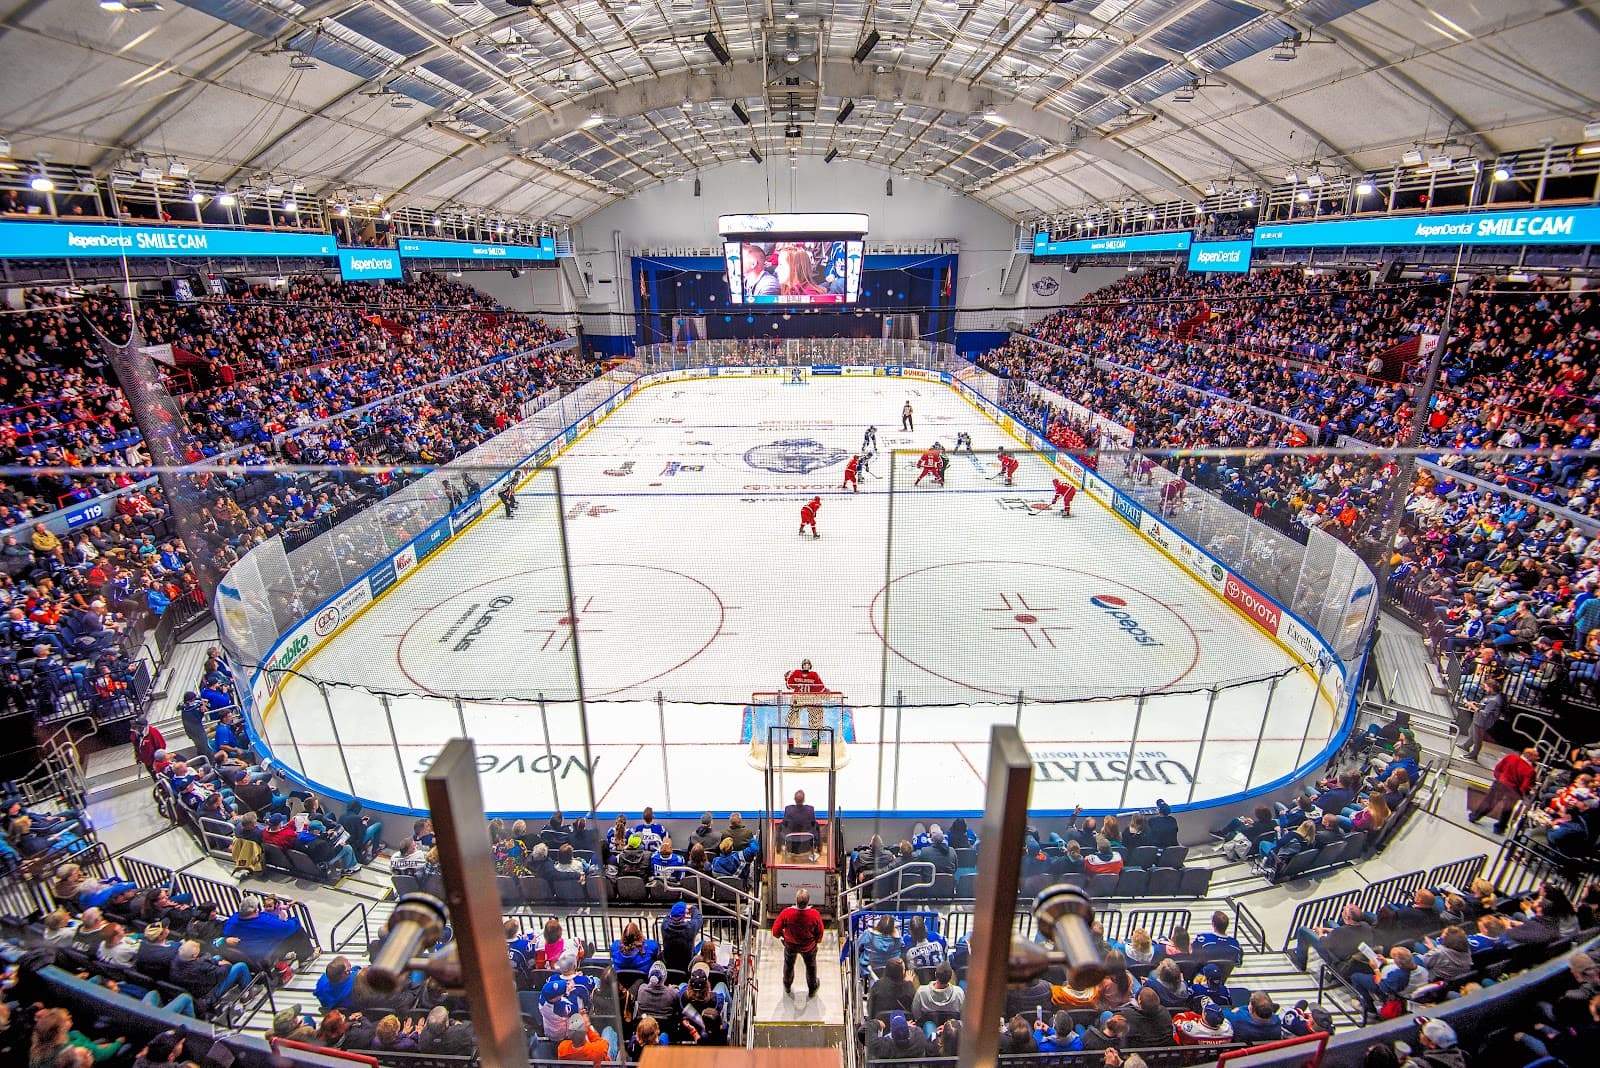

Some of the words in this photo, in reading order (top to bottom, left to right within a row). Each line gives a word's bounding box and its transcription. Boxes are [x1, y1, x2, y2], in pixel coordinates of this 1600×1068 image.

[1477, 218, 1527, 236] SMILE
[1528, 216, 1574, 235] CAM
[136, 233, 177, 248] SMILE
[179, 235, 208, 249] CAM
[648, 247, 701, 256] MEMORY
[893, 241, 960, 255] VETERANS
[84, 505, 102, 520] 119
[1114, 492, 1141, 521] UPSTATE
[1241, 590, 1277, 628] TOYOTA
[1104, 610, 1164, 646] pepsi
[1287, 623, 1318, 659] Excellus
[1033, 759, 1202, 785] UPSTAT
